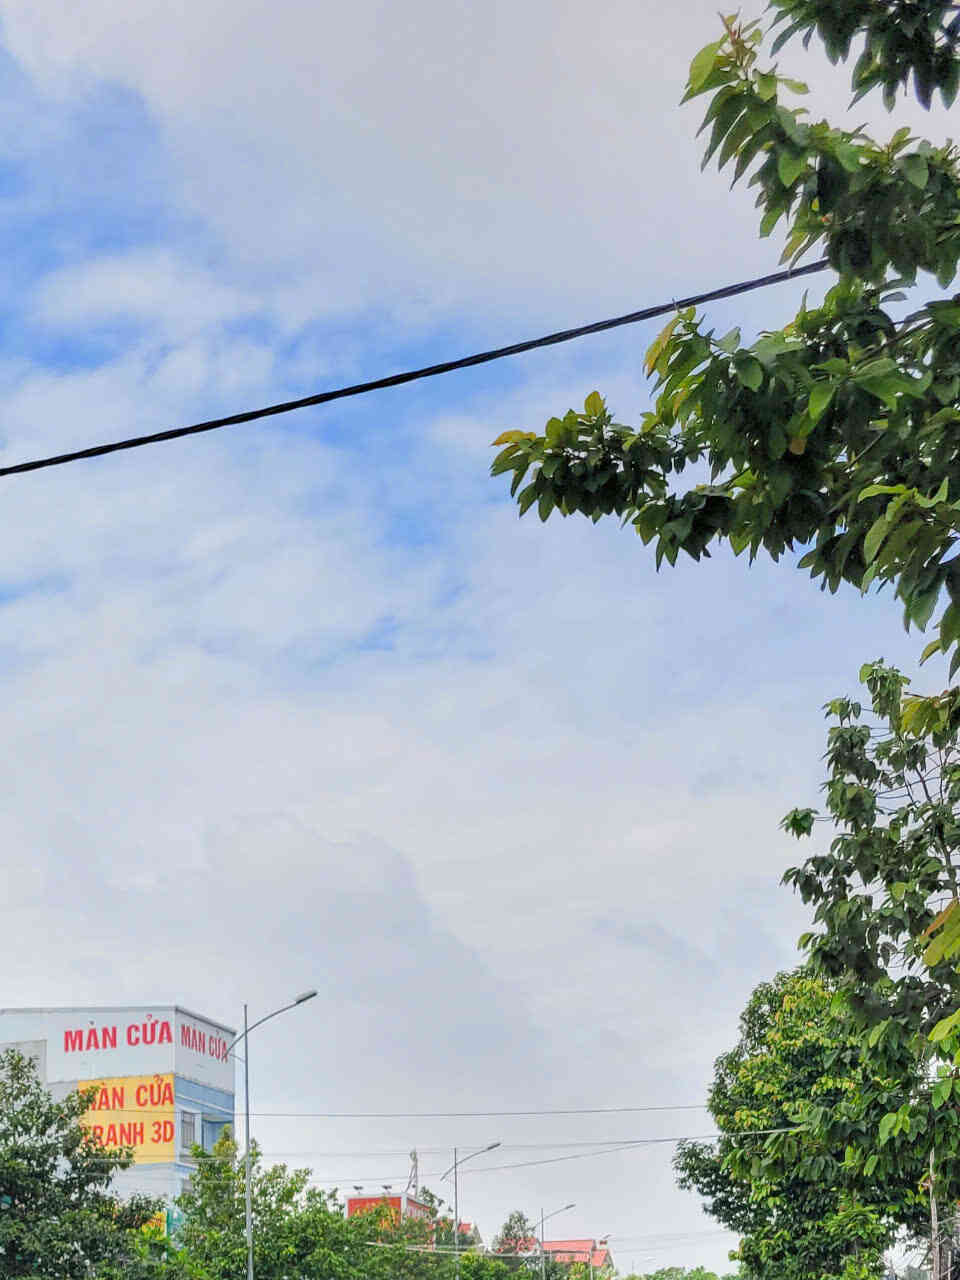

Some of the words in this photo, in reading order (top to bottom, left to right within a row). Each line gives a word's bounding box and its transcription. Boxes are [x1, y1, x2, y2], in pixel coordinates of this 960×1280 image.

[126, 1014, 173, 1047] CỬA
[136, 1074, 175, 1108] CỬA
[151, 1120, 175, 1144] 3D
